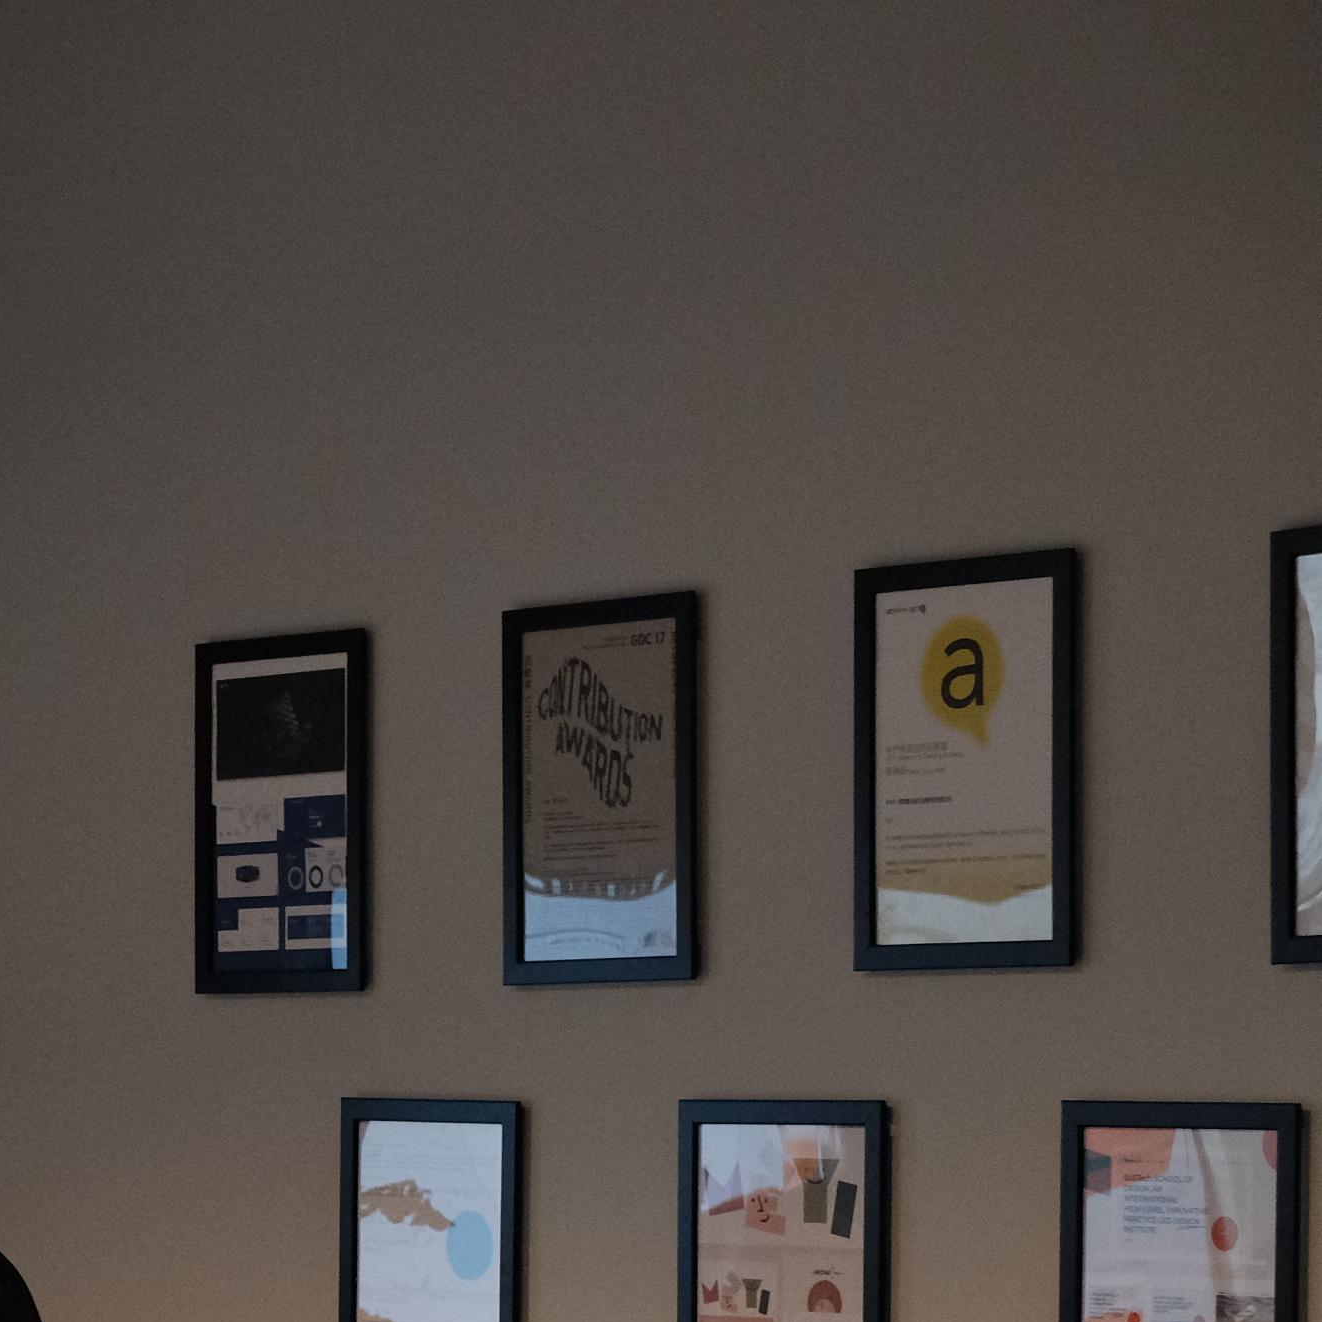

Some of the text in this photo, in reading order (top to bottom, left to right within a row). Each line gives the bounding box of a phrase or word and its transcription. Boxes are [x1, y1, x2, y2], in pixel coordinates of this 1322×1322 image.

[630, 631, 665, 646] GDC 17
[941, 637, 985, 709] a
[538, 657, 663, 743] CONTRIBUTION
[556, 721, 633, 808] AWARDS
